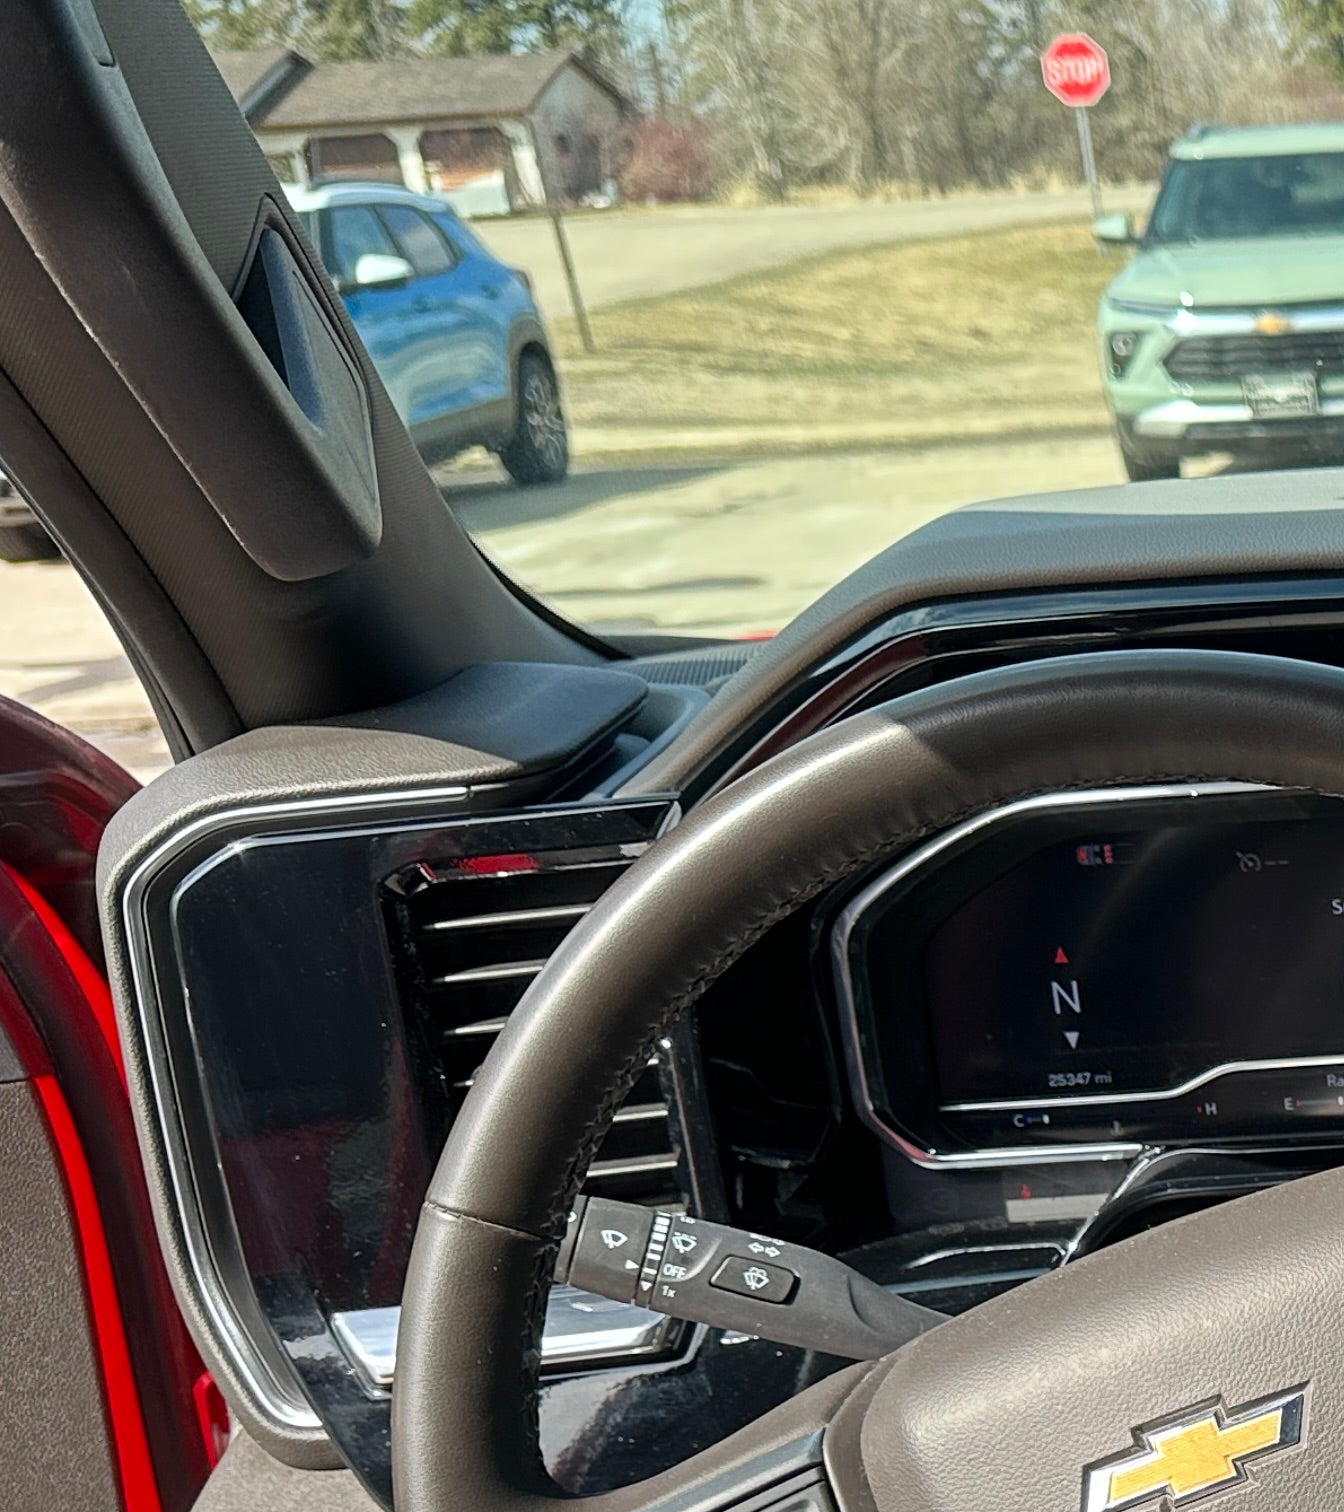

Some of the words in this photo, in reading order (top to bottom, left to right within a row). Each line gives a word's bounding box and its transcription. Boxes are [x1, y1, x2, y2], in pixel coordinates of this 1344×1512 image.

[1046, 57, 1104, 83] STOP
[1050, 979, 1081, 1015] N
[1047, 1071, 1092, 1088] 25347
[1093, 1069, 1114, 1085] mi
[1205, 1101, 1218, 1116] H
[1283, 1097, 1295, 1111] E
[1013, 1113, 1025, 1128] C
[662, 1263, 687, 1279] OFF
